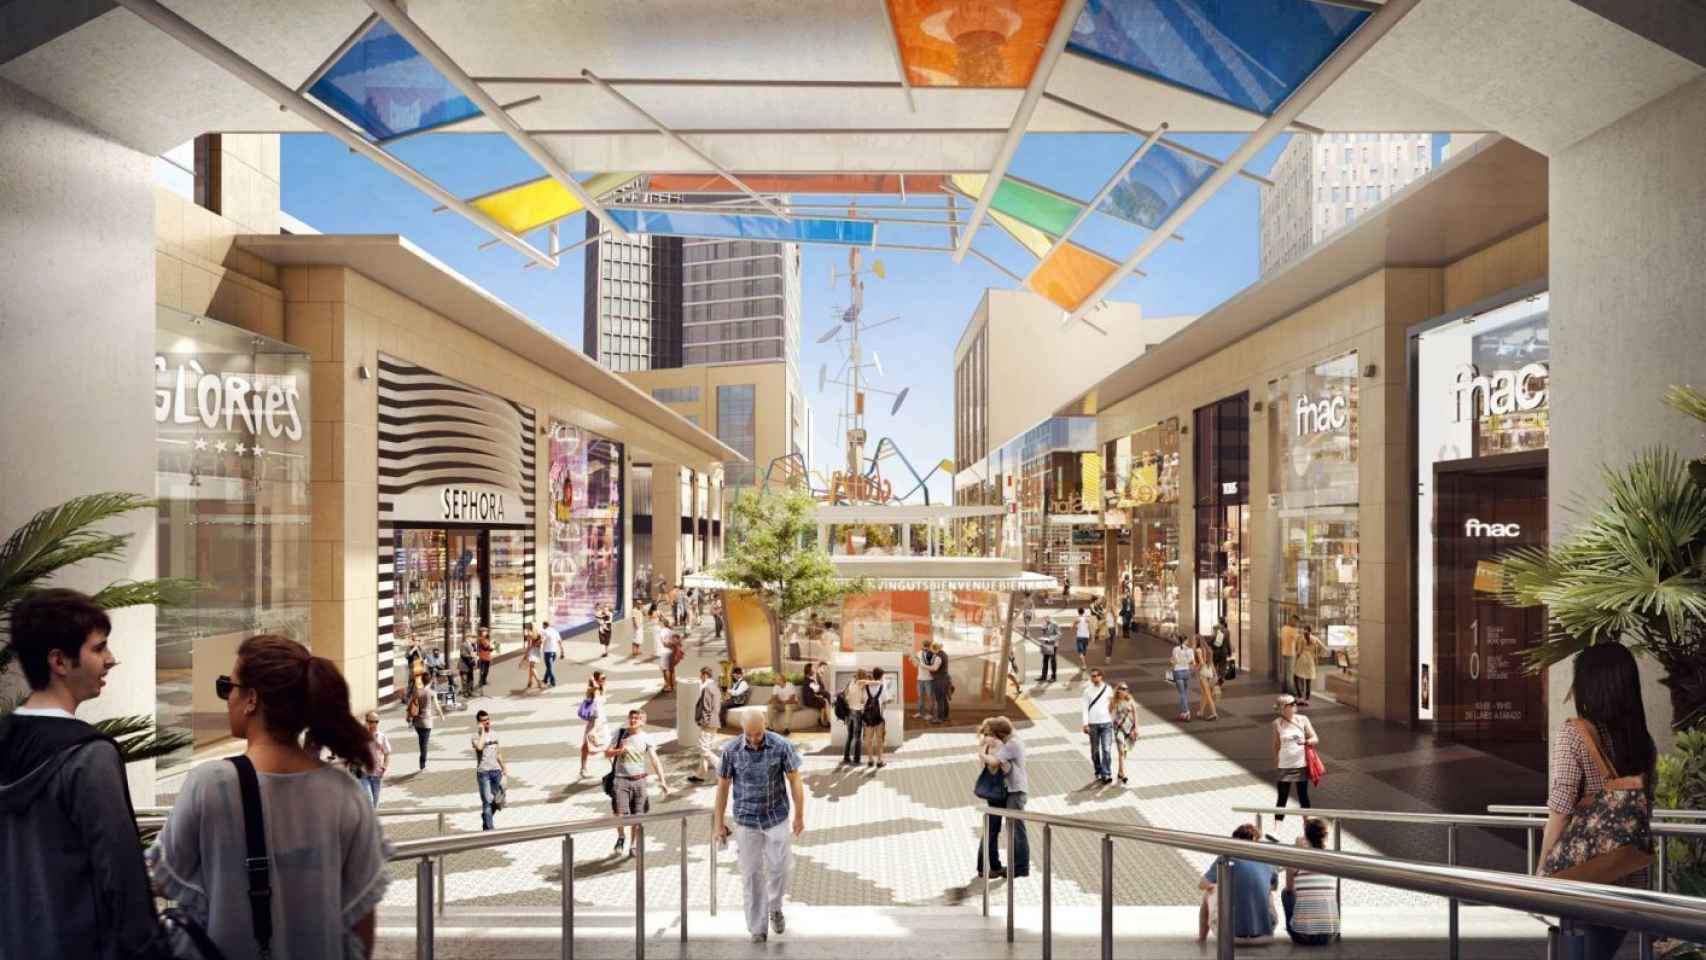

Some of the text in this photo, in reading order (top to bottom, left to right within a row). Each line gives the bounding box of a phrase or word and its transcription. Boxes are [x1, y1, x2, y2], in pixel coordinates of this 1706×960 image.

[1452, 363, 1549, 423] fnac
[1296, 394, 1346, 436] fnac
[443, 488, 504, 521] SEPHORA
[1465, 518, 1521, 537] fnac
